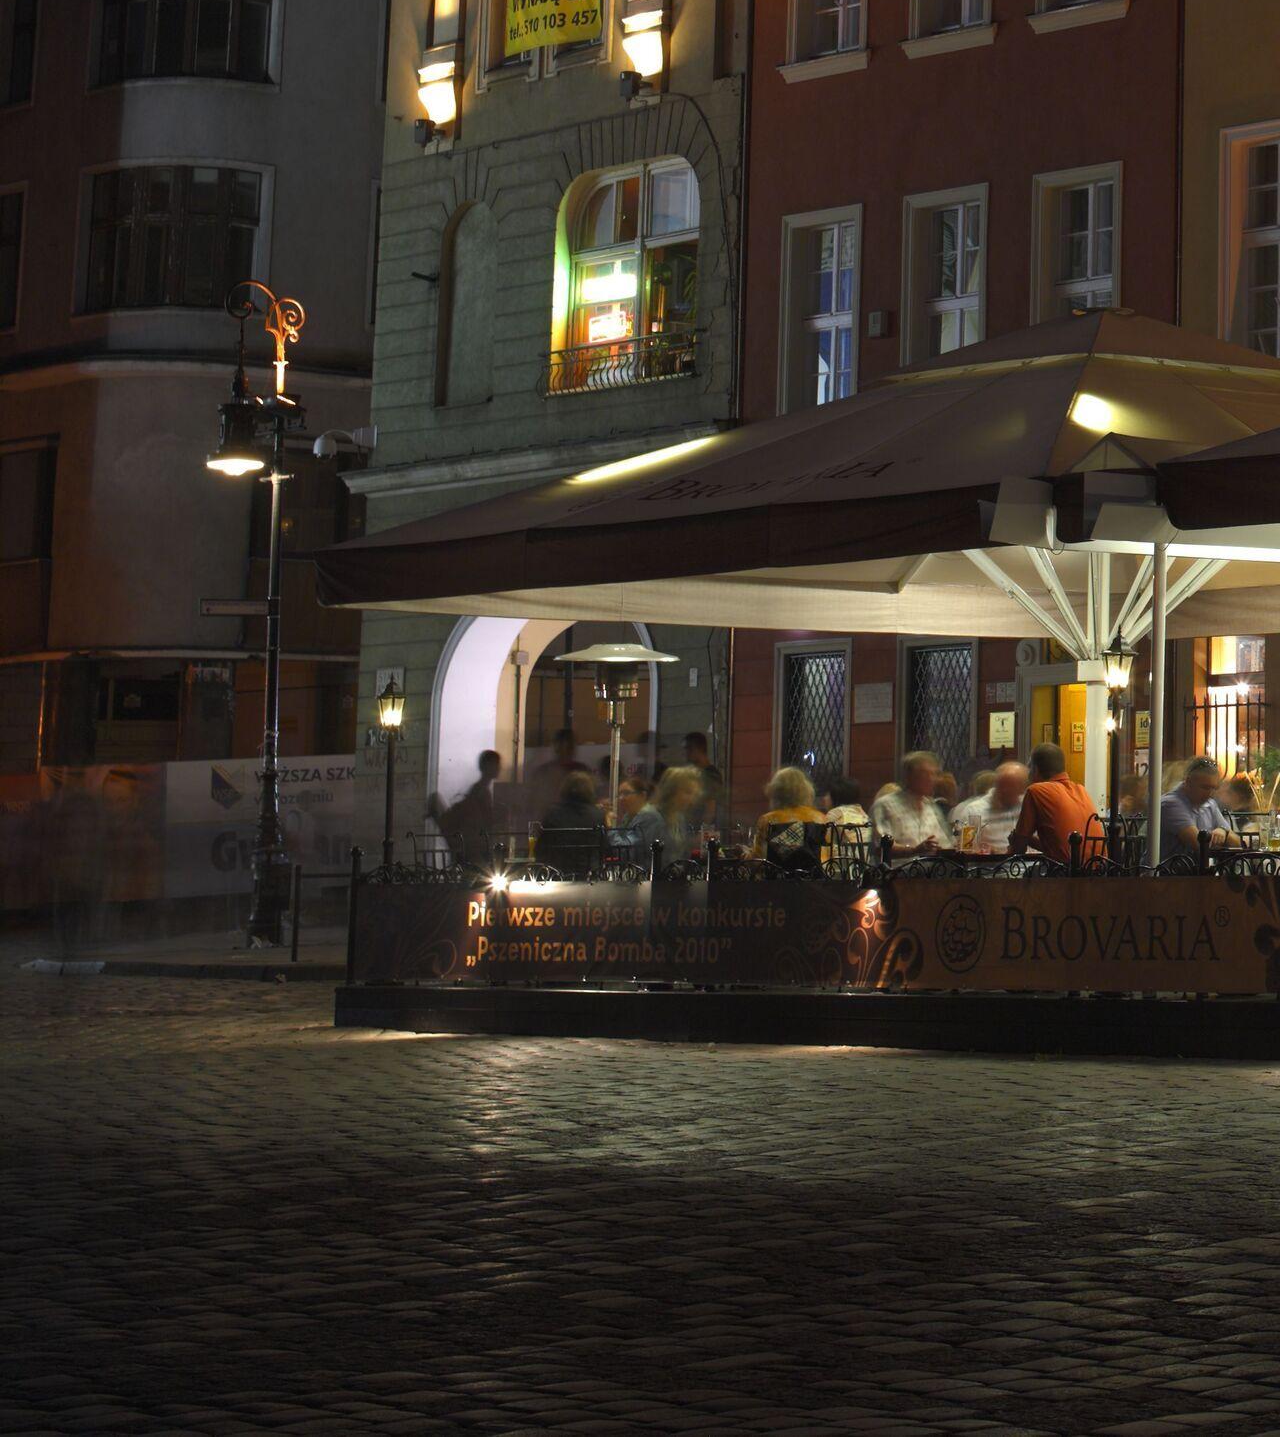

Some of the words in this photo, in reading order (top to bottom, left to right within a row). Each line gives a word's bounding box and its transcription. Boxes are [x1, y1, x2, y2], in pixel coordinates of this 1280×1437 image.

[542, 12, 566, 30] 103
[572, 9, 598, 26] 457
[254, 766, 321, 783] WŻSZA
[467, 900, 555, 928] Piewsze
[562, 901, 644, 932] miejsce
[651, 906, 671, 927] w
[677, 901, 787, 928] konkursie
[595, 936, 666, 963] Bomba
